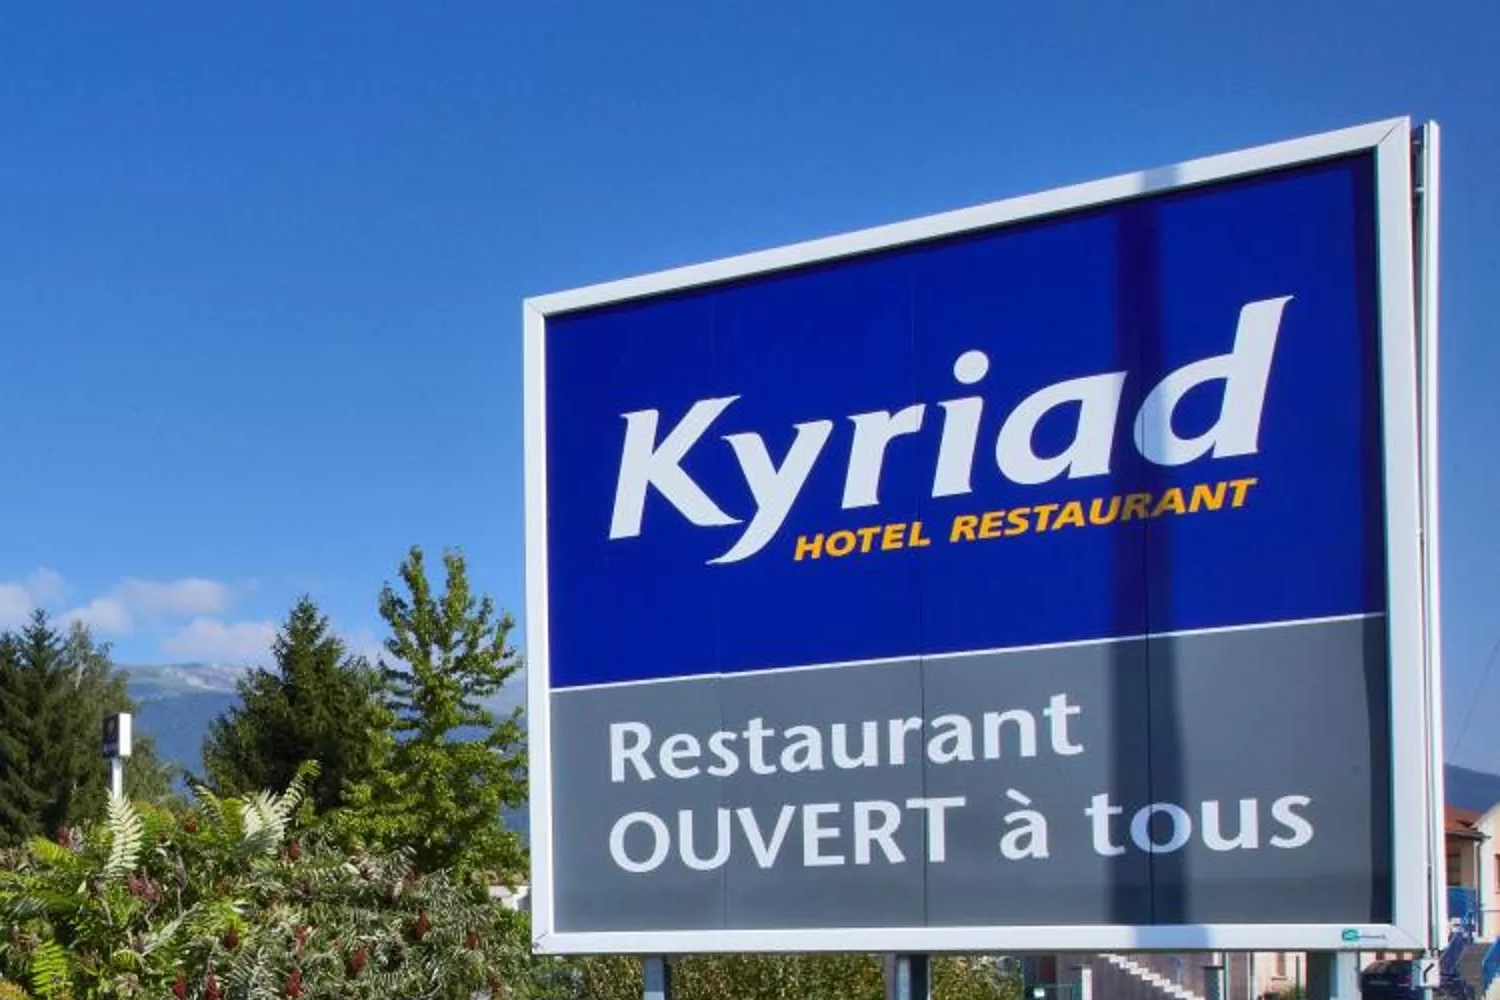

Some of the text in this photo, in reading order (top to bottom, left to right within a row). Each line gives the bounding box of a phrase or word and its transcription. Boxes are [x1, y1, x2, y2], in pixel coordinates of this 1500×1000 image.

[608, 295, 1294, 566] Kyriad
[793, 476, 1259, 562] HOTEL RESTAURANT
[608, 692, 1084, 784] Restaurant
[608, 787, 1315, 874] OUVERT à tous
